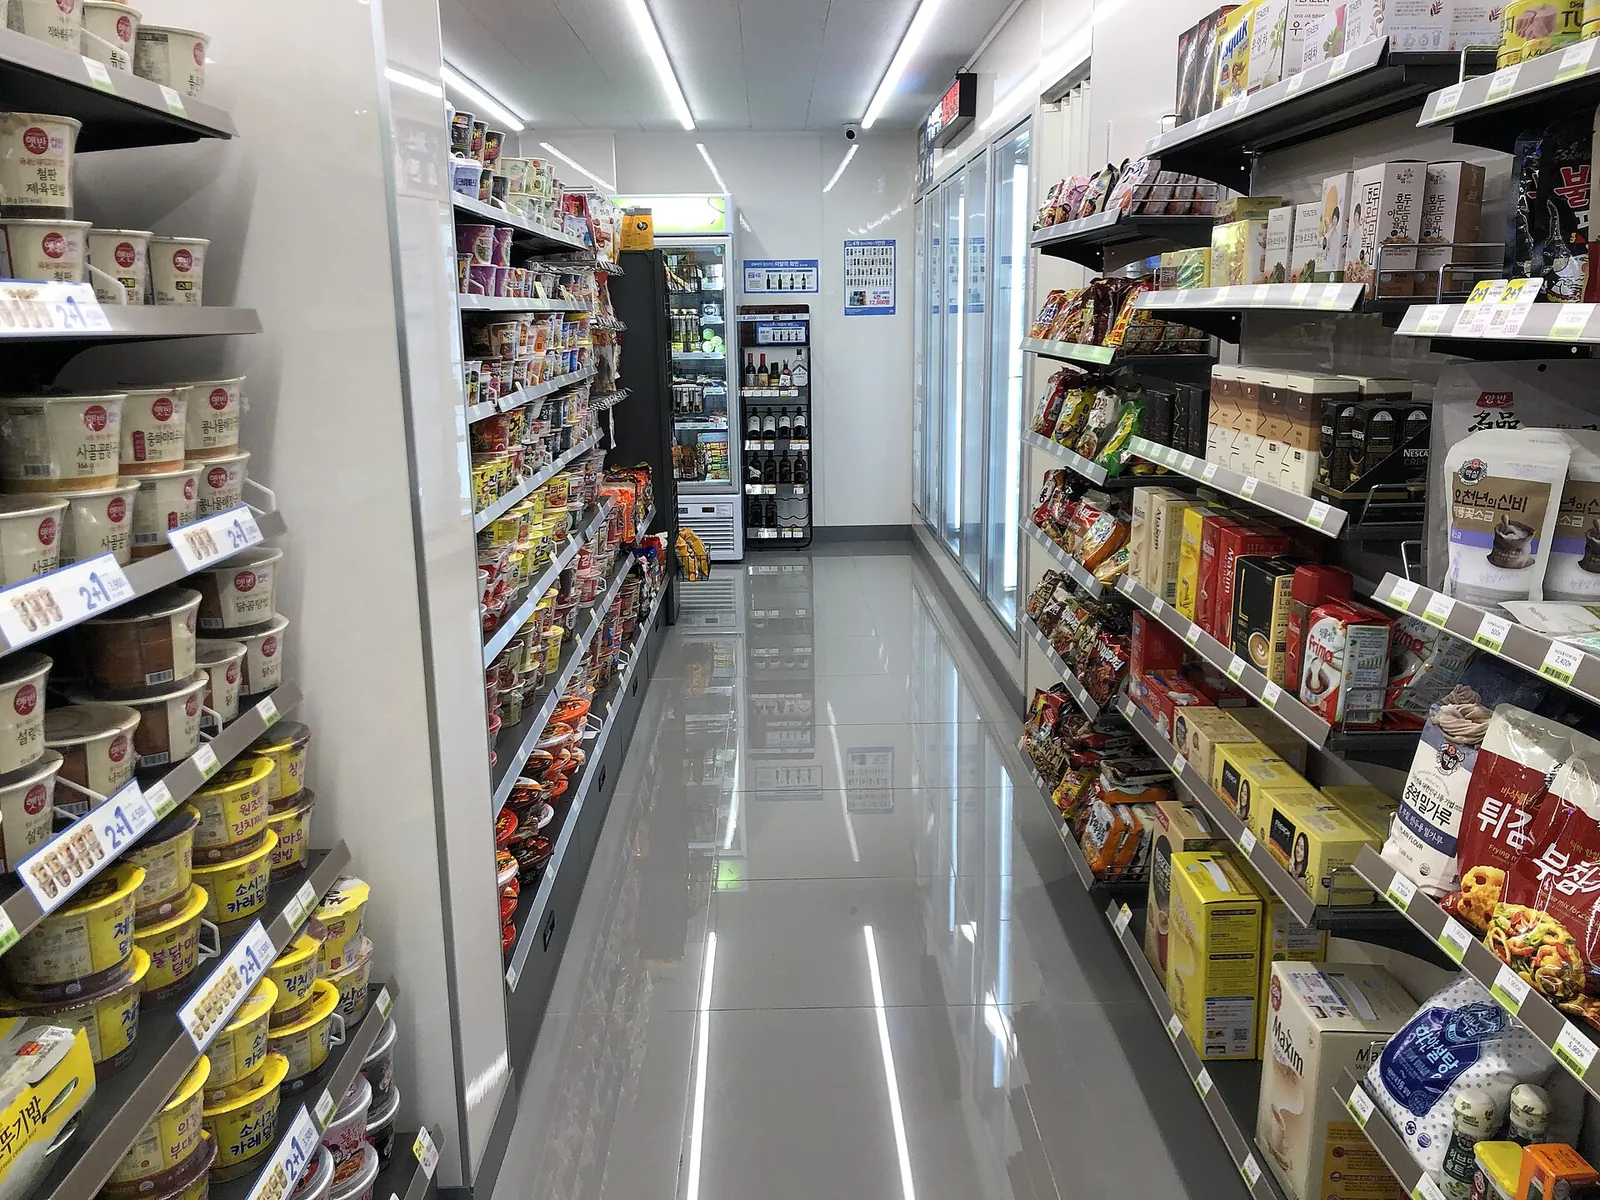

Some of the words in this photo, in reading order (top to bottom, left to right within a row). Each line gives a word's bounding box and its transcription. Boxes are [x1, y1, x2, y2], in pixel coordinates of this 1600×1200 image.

[1217, 20, 1247, 66] Nsquik
[26, 137, 46, 149] 햇반
[485, 140, 498, 149] THE
[26, 182, 65, 197] 제육덮밥
[37, 168, 57, 181] 철판
[1554, 165, 1592, 208] 불
[1470, 287, 1490, 302] 2+1
[1501, 287, 1521, 302] 2+1
[56, 295, 88, 328] 2+1
[1484, 393, 1508, 405] 양반
[1403, 449, 1429, 457] NESCA
[227, 518, 250, 549] 2+1
[1154, 508, 1162, 550] Maxim
[1224, 546, 1235, 595] Maxim
[79, 571, 112, 611] 2+1
[1554, 655, 1572, 668] 2,400원
[1404, 781, 1453, 826] 중력밀가루
[104, 805, 136, 850] 2+1
[1477, 796, 1533, 850] 튀김
[227, 884, 269, 913] 카레덮
[239, 945, 262, 986] 2+1
[1272, 1014, 1305, 1077] Maxim
[1356, 1047, 1379, 1062] Ma
[1415, 1023, 1460, 1074] 하얀설탕
[1566, 1041, 1586, 1059] 5,900원
[0, 1095, 44, 1159] 뚜기밥
[286, 1135, 306, 1180] 2+1
